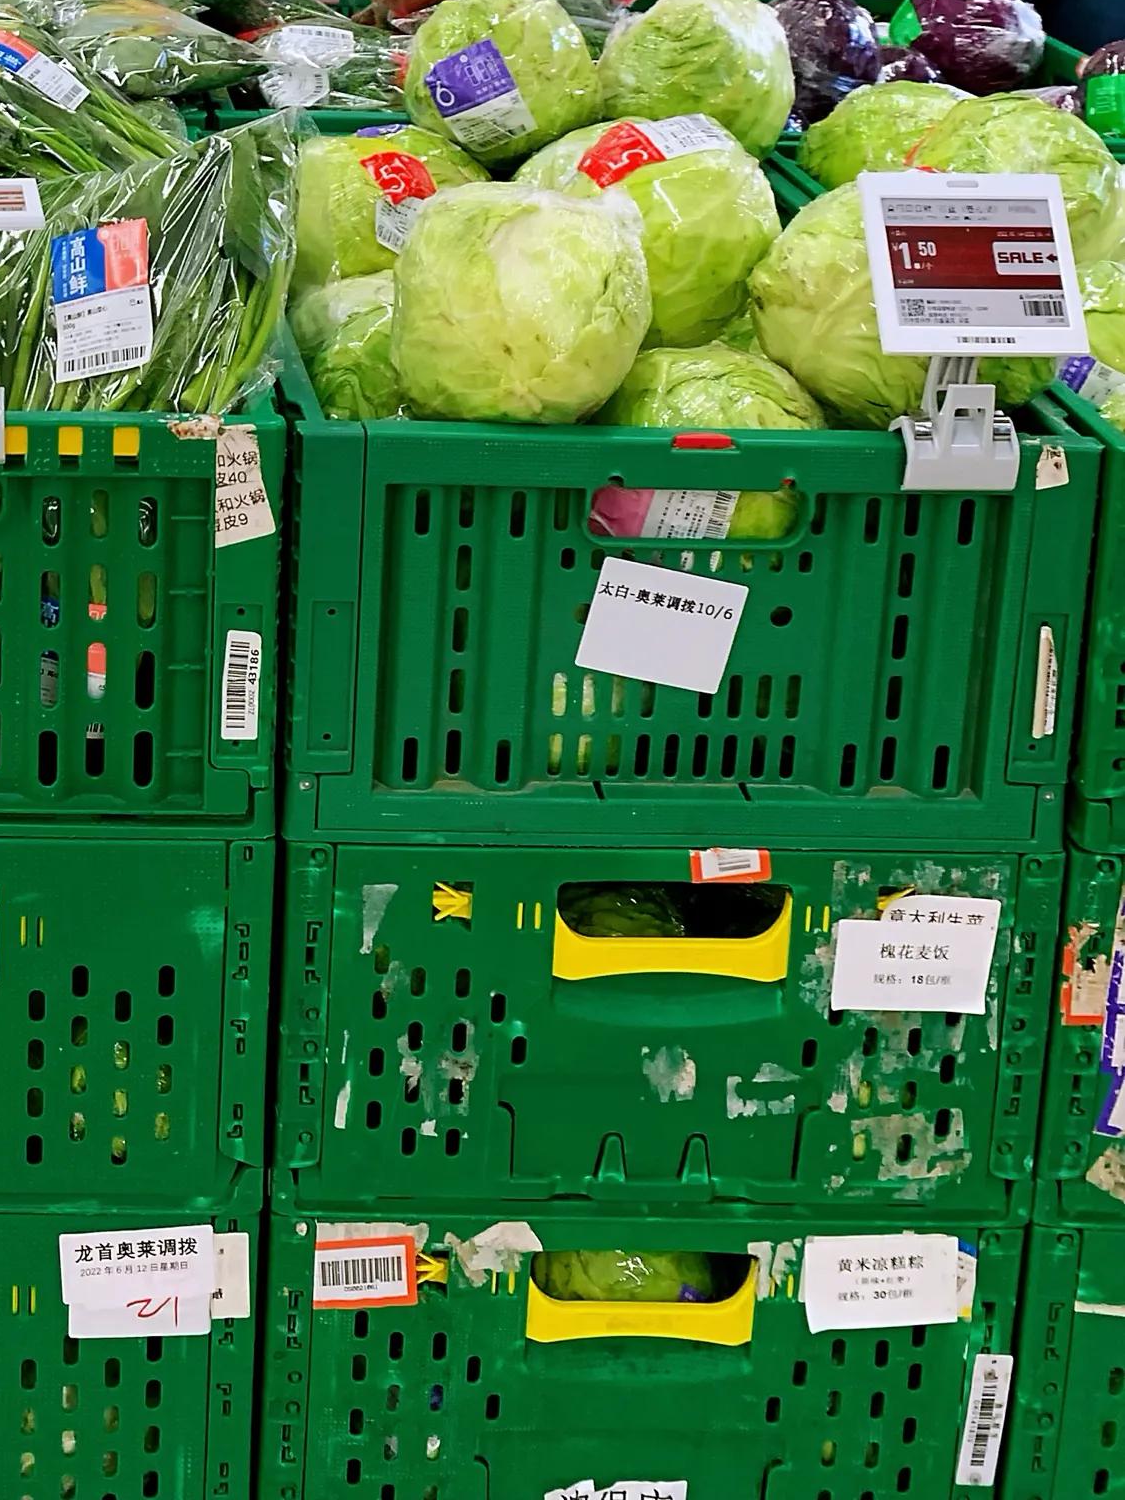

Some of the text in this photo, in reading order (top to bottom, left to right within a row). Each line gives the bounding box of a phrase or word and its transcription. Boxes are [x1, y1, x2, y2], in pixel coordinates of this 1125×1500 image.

[68, 235, 89, 296] 高山鲜
[996, 251, 1044, 264] SALE
[248, 648, 260, 685] 43186
[880, 942, 951, 961] 槐花麦饭
[74, 1236, 199, 1264] 龙首奥莱调拨
